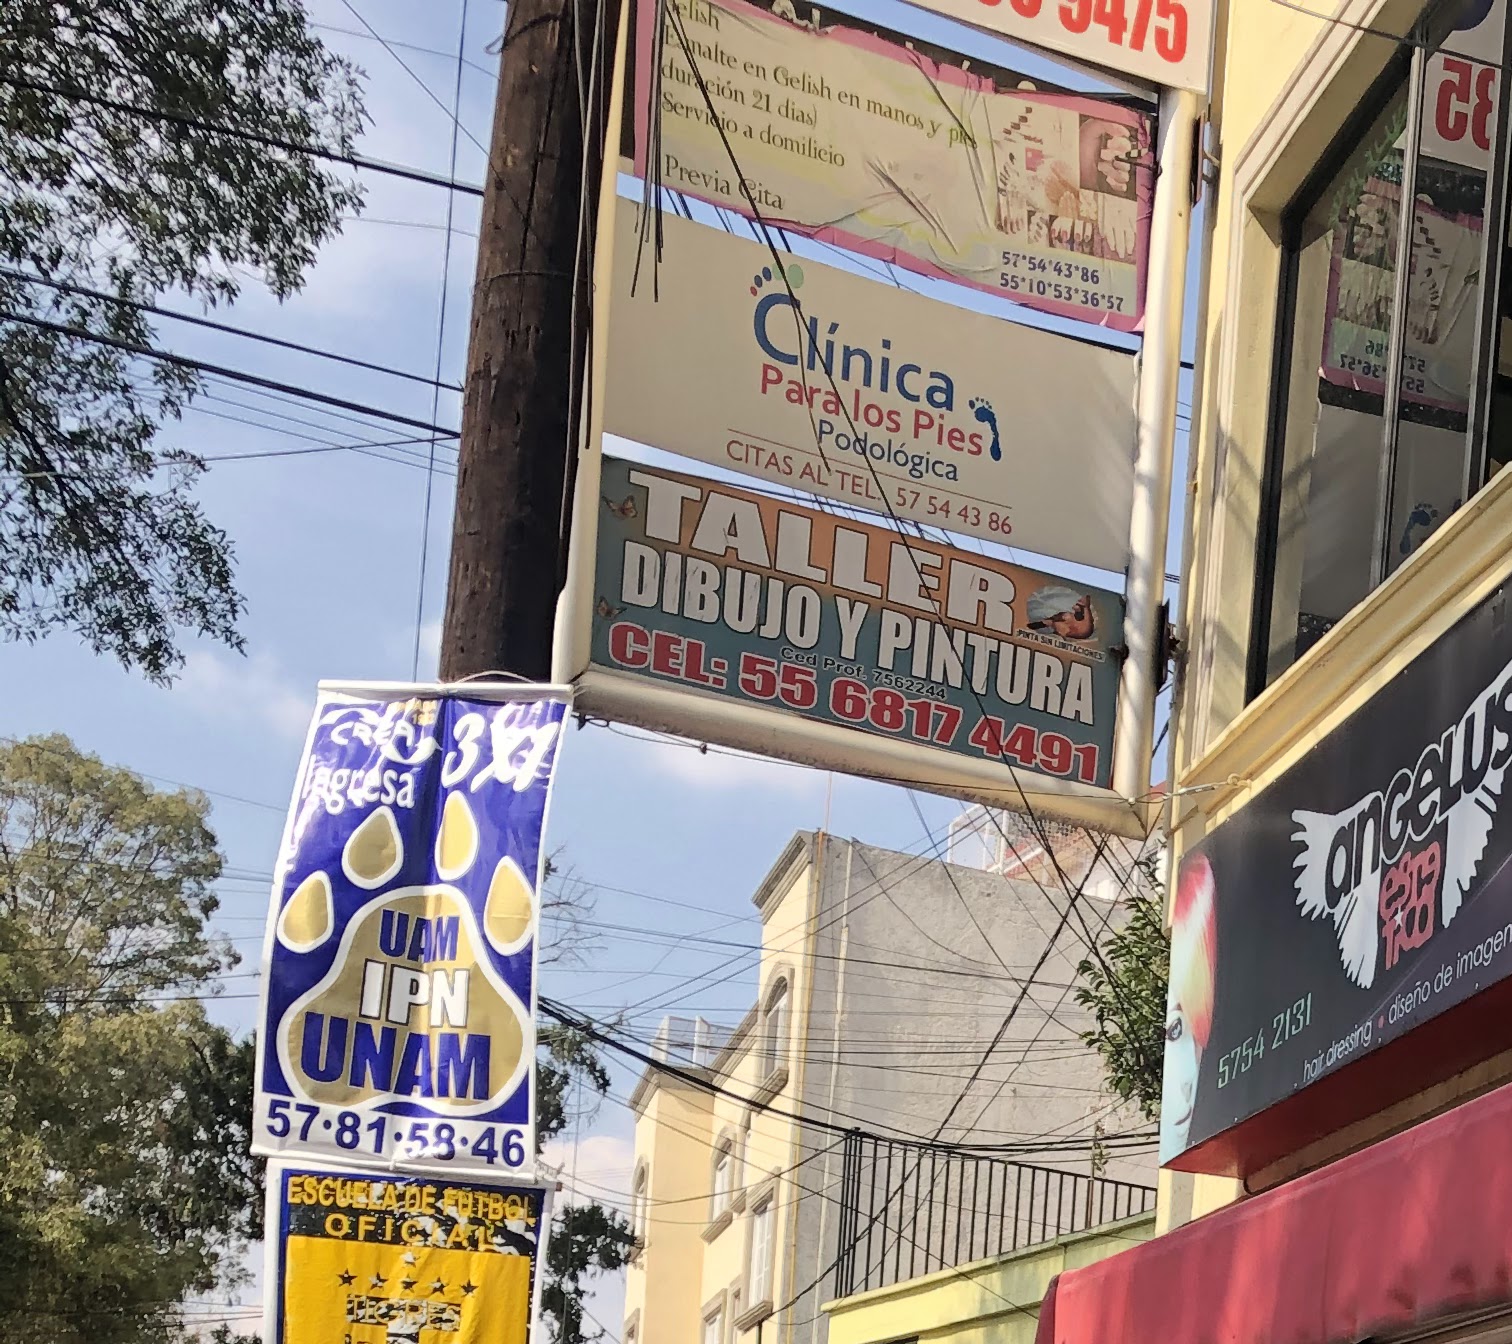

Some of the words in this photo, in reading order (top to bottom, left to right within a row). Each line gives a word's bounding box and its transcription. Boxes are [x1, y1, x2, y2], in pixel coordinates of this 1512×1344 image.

[742, 124, 753, 140] a
[743, 60, 766, 81] en
[773, 65, 832, 101] Gelish
[838, 88, 860, 110] en
[866, 100, 924, 130] manos
[924, 118, 942, 140] y
[751, 89, 771, 113] 21
[665, 153, 731, 196] Previa
[738, 178, 784, 211] Cita
[754, 293, 954, 412] Clínica
[761, 363, 840, 416] Para
[852, 388, 901, 433] los
[913, 409, 983, 457] Pies
[818, 419, 958, 481] Podológica
[726, 439, 793, 475] CITAS
[799, 458, 829, 487] AL
[831, 470, 881, 501] TEL.
[895, 487, 920, 510] 57
[926, 495, 950, 518] 54
[957, 504, 981, 527] 43
[988, 512, 1013, 535] 86
[628, 468, 1017, 636] TALLER
[621, 540, 822, 650] DIBUJO
[834, 596, 870, 661] Y
[877, 607, 1096, 726] PINTURA
[781, 647, 817, 666] Ced
[873, 669, 946, 699] 7562244
[608, 621, 728, 689] CEL:
[738, 651, 819, 711] 55
[830, 676, 963, 748] 6817
[969, 712, 1099, 787] 4491
[379, 909, 460, 962] UAM
[359, 958, 471, 1029] IPN
[1326, 1020, 1373, 1067] dressing
[1388, 981, 1431, 1024] diseño
[1434, 963, 1453, 993] de
[1456, 923, 1512, 979] imagen
[300, 1012, 492, 1101] UNAM
[1217, 1028, 1265, 1088] 5754
[1271, 992, 1313, 1046] 2131
[287, 1175, 401, 1211] ESCUELA
[404, 1184, 436, 1214] DE
[441, 1188, 535, 1224] FUTBOL
[324, 1213, 499, 1250] OFICIAL
